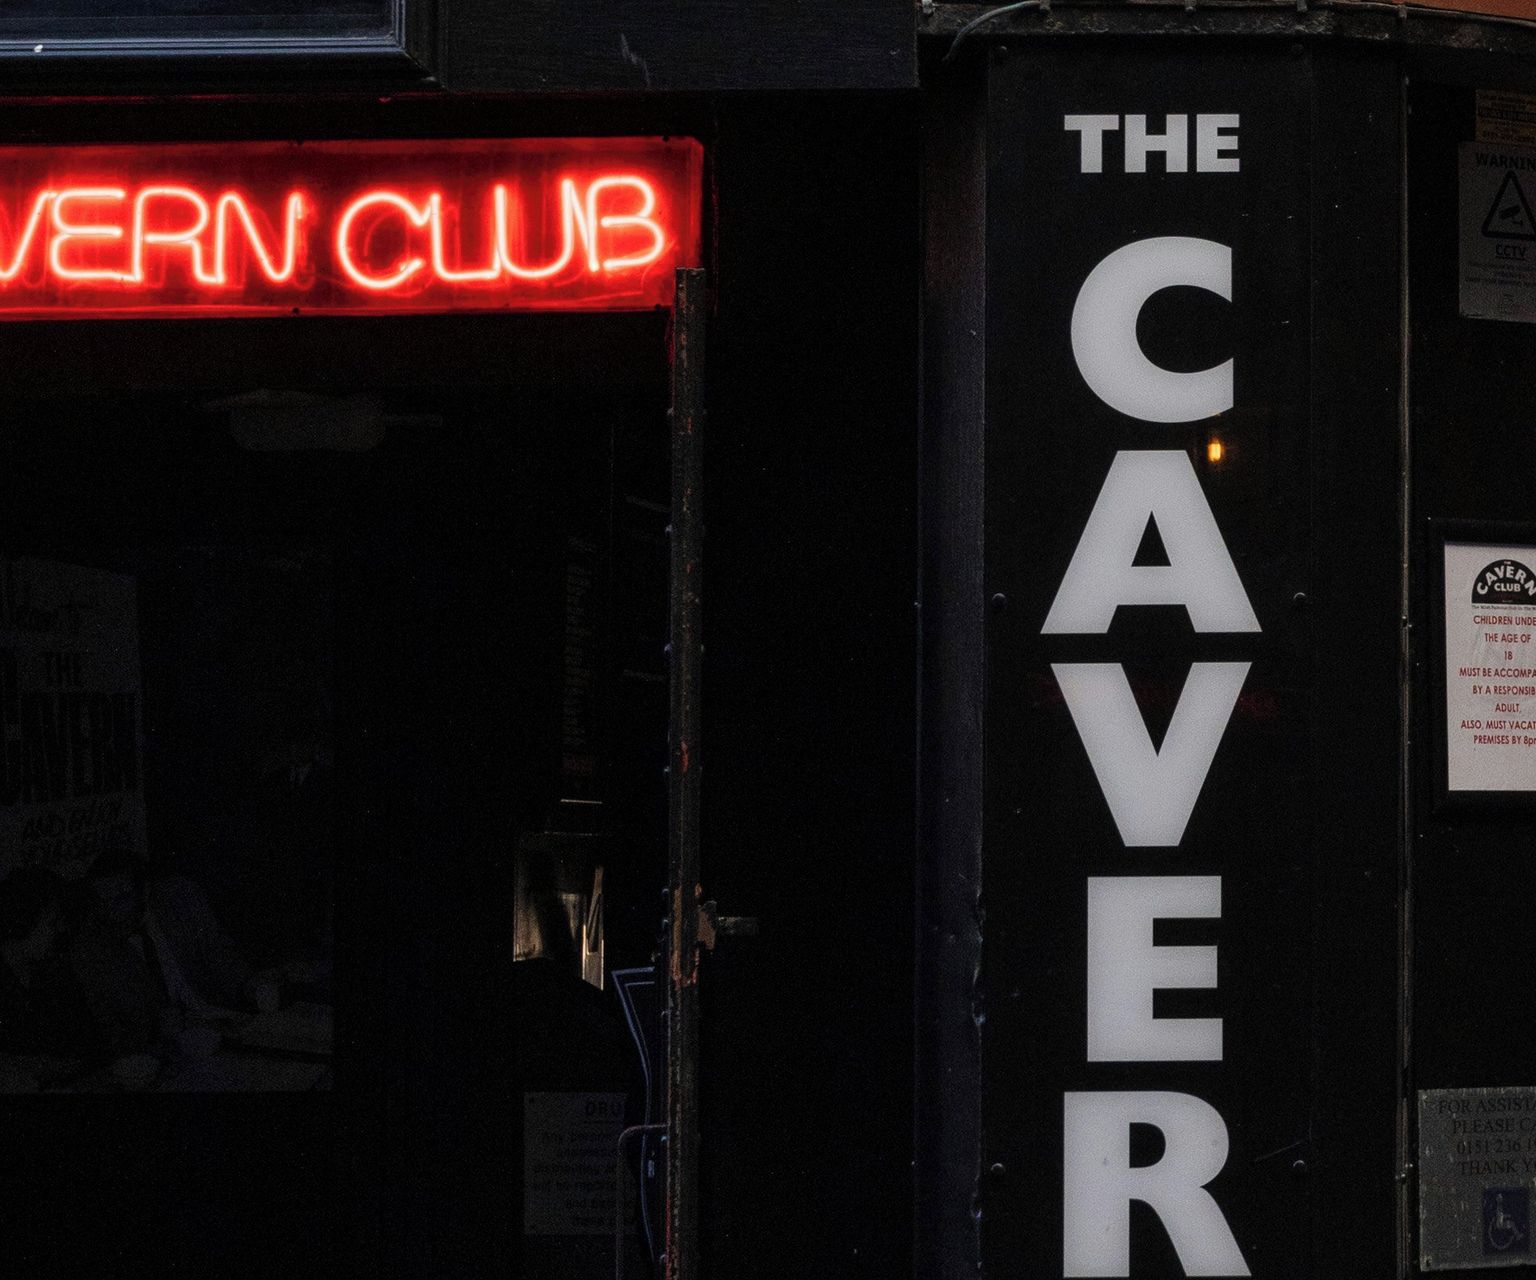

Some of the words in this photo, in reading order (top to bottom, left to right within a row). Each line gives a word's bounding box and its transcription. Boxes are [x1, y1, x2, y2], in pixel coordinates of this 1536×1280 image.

[1064, 113, 1240, 173] THE
[334, 174, 668, 291] CLUB
[1495, 244, 1526, 257] CCTV
[1494, 582, 1521, 592] CLUB
[1473, 615, 1512, 625] CHILDREN
[1485, 632, 1498, 642] THE
[1500, 633, 1519, 643] AGE
[1520, 633, 1531, 643] OF
[1504, 651, 1513, 661] 18
[1459, 667, 1480, 677] MUST
[1482, 668, 1492, 677] BE
[1472, 685, 1482, 694] BY
[1485, 685, 1492, 695] A
[1485, 720, 1507, 729] MUST
[1473, 735, 1510, 745] PREMISES
[1512, 735, 1522, 745] BY
[1438, 1100, 1471, 1114] FOR
[1452, 1118, 1515, 1134] PLEASE
[1456, 1139, 1491, 1155] 0151
[1496, 1139, 1521, 1153] 236
[1457, 1160, 1516, 1176] THANK
